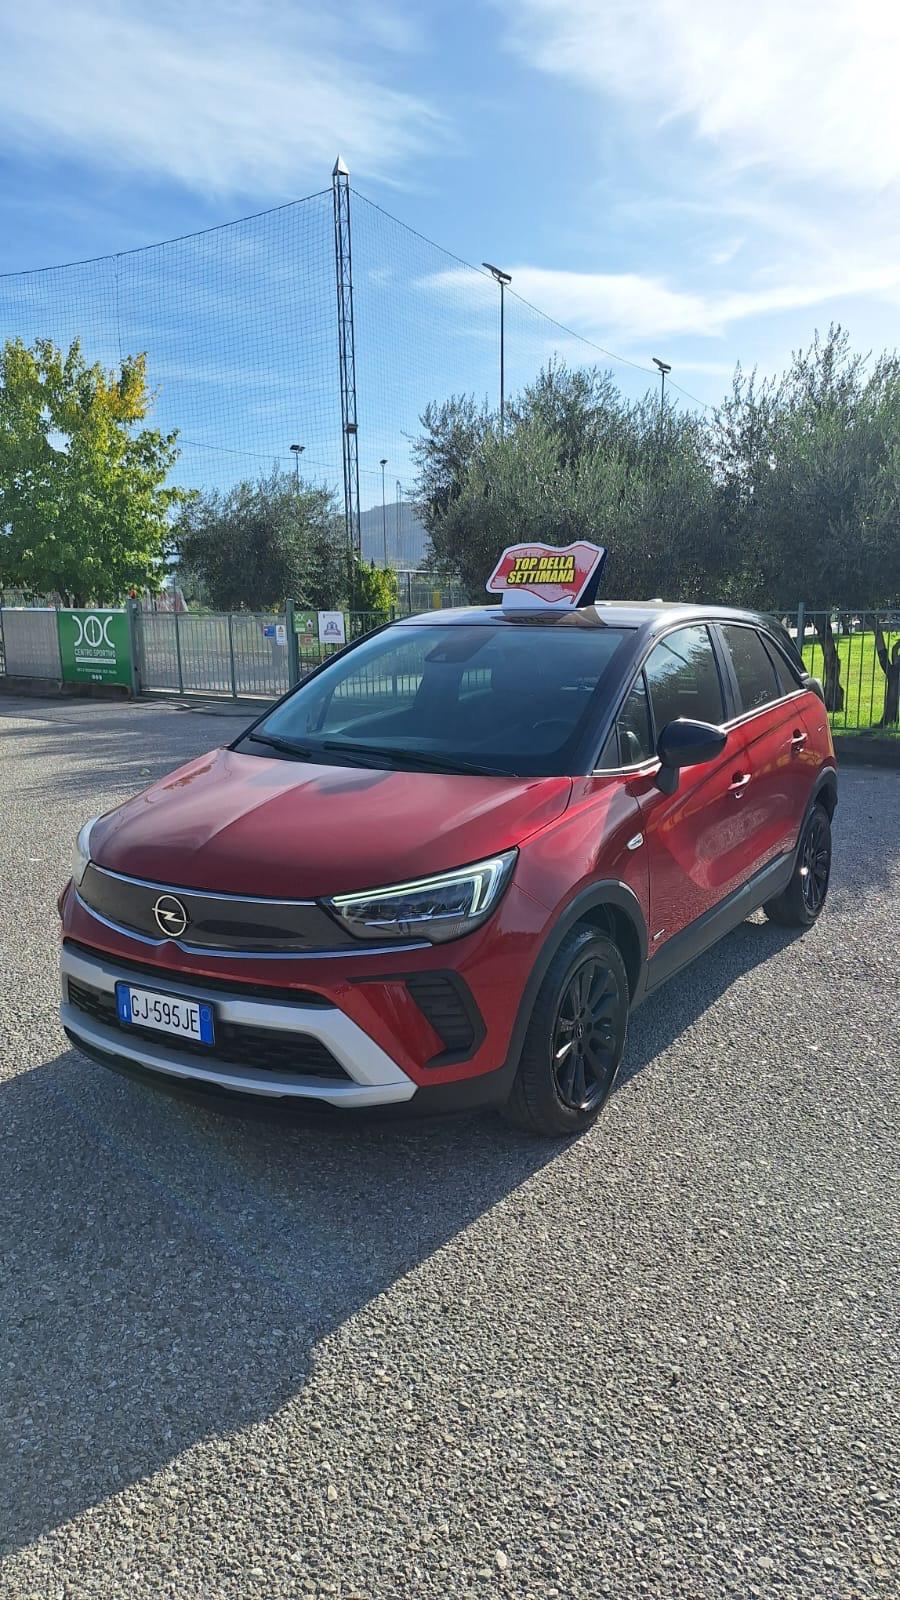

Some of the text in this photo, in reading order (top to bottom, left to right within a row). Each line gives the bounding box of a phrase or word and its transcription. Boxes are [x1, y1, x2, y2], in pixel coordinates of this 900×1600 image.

[514, 556, 574, 570] TOP DELLA
[507, 570, 575, 583] SETTIMANA
[74, 648, 93, 656] CENTRO
